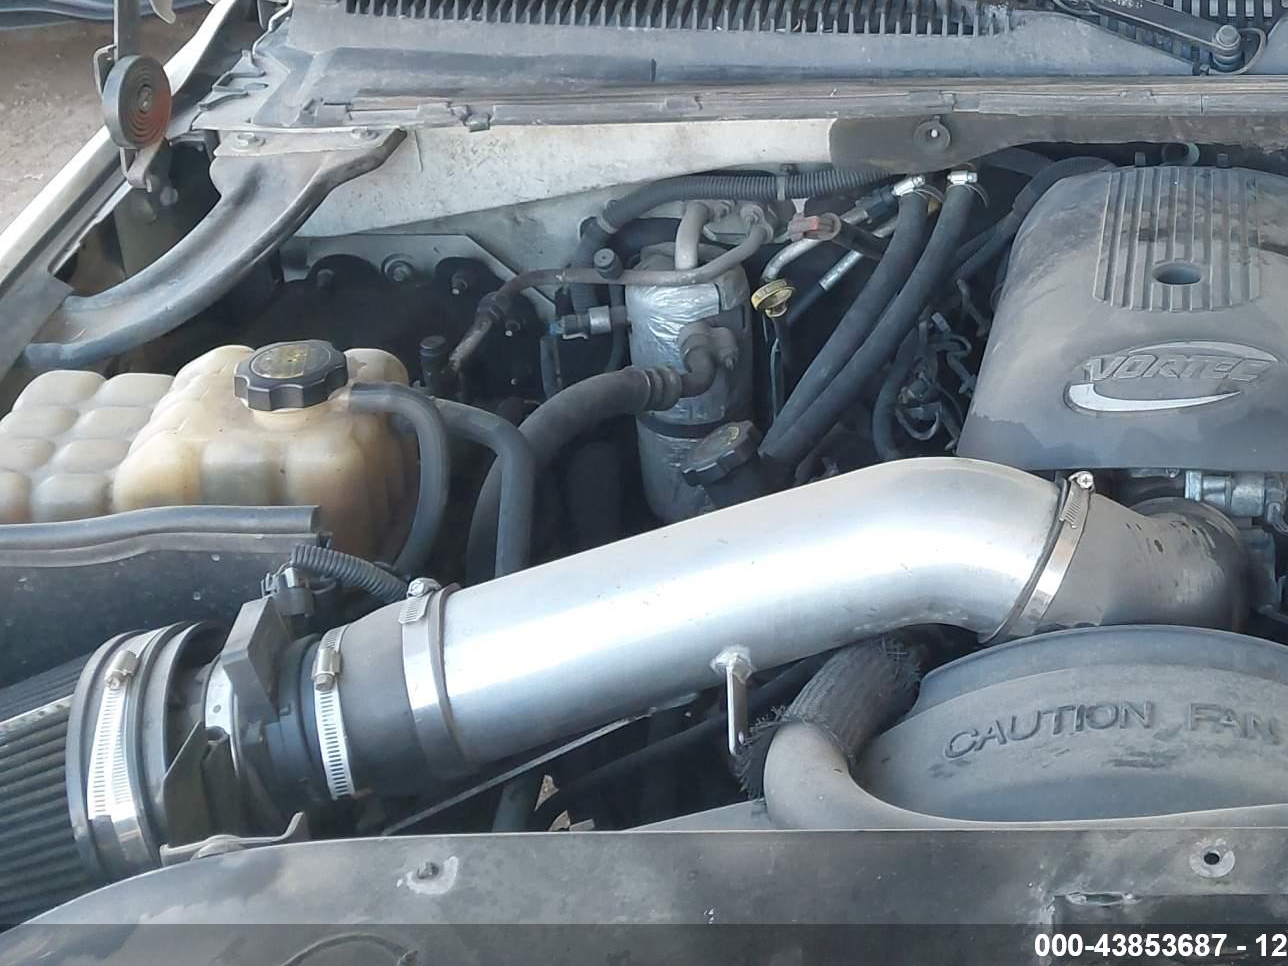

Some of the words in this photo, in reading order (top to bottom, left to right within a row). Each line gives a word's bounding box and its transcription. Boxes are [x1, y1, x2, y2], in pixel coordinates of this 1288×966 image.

[1086, 353, 1272, 383] VORTEC
[943, 700, 1156, 760] CAUTION
[1188, 701, 1280, 745] FAN
